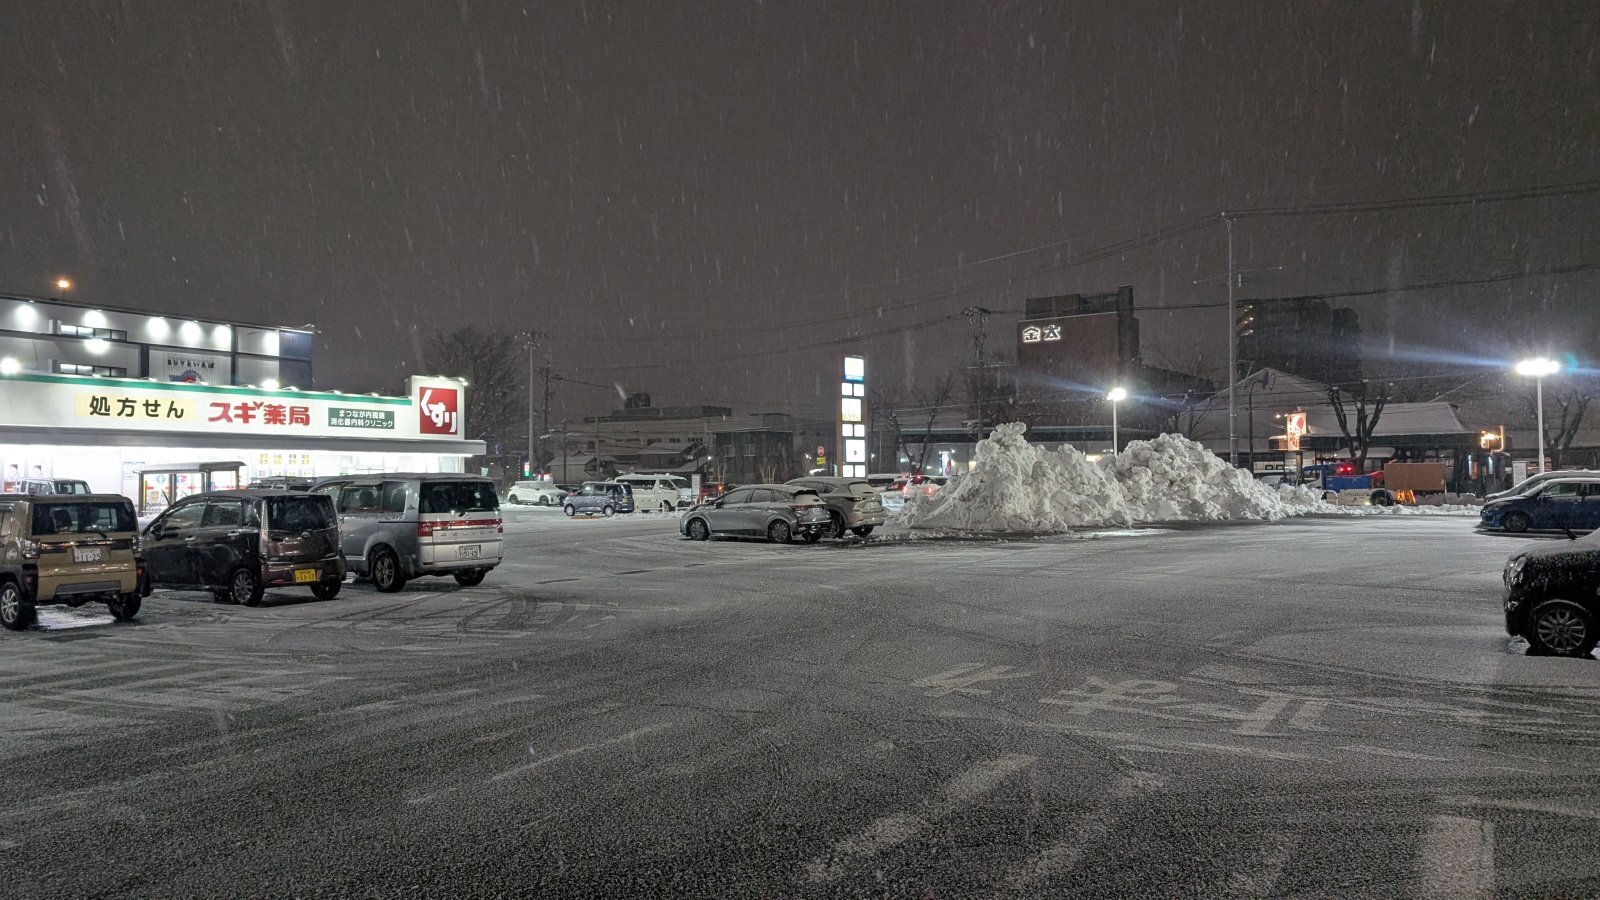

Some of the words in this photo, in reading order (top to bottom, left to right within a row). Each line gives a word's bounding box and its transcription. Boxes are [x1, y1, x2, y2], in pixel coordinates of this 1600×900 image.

[89, 395, 185, 419] 処方せん
[208, 400, 311, 426] スギ薬局
[420, 389, 457, 433] くすり
[330, 417, 393, 428] 消化器内科クリニック
